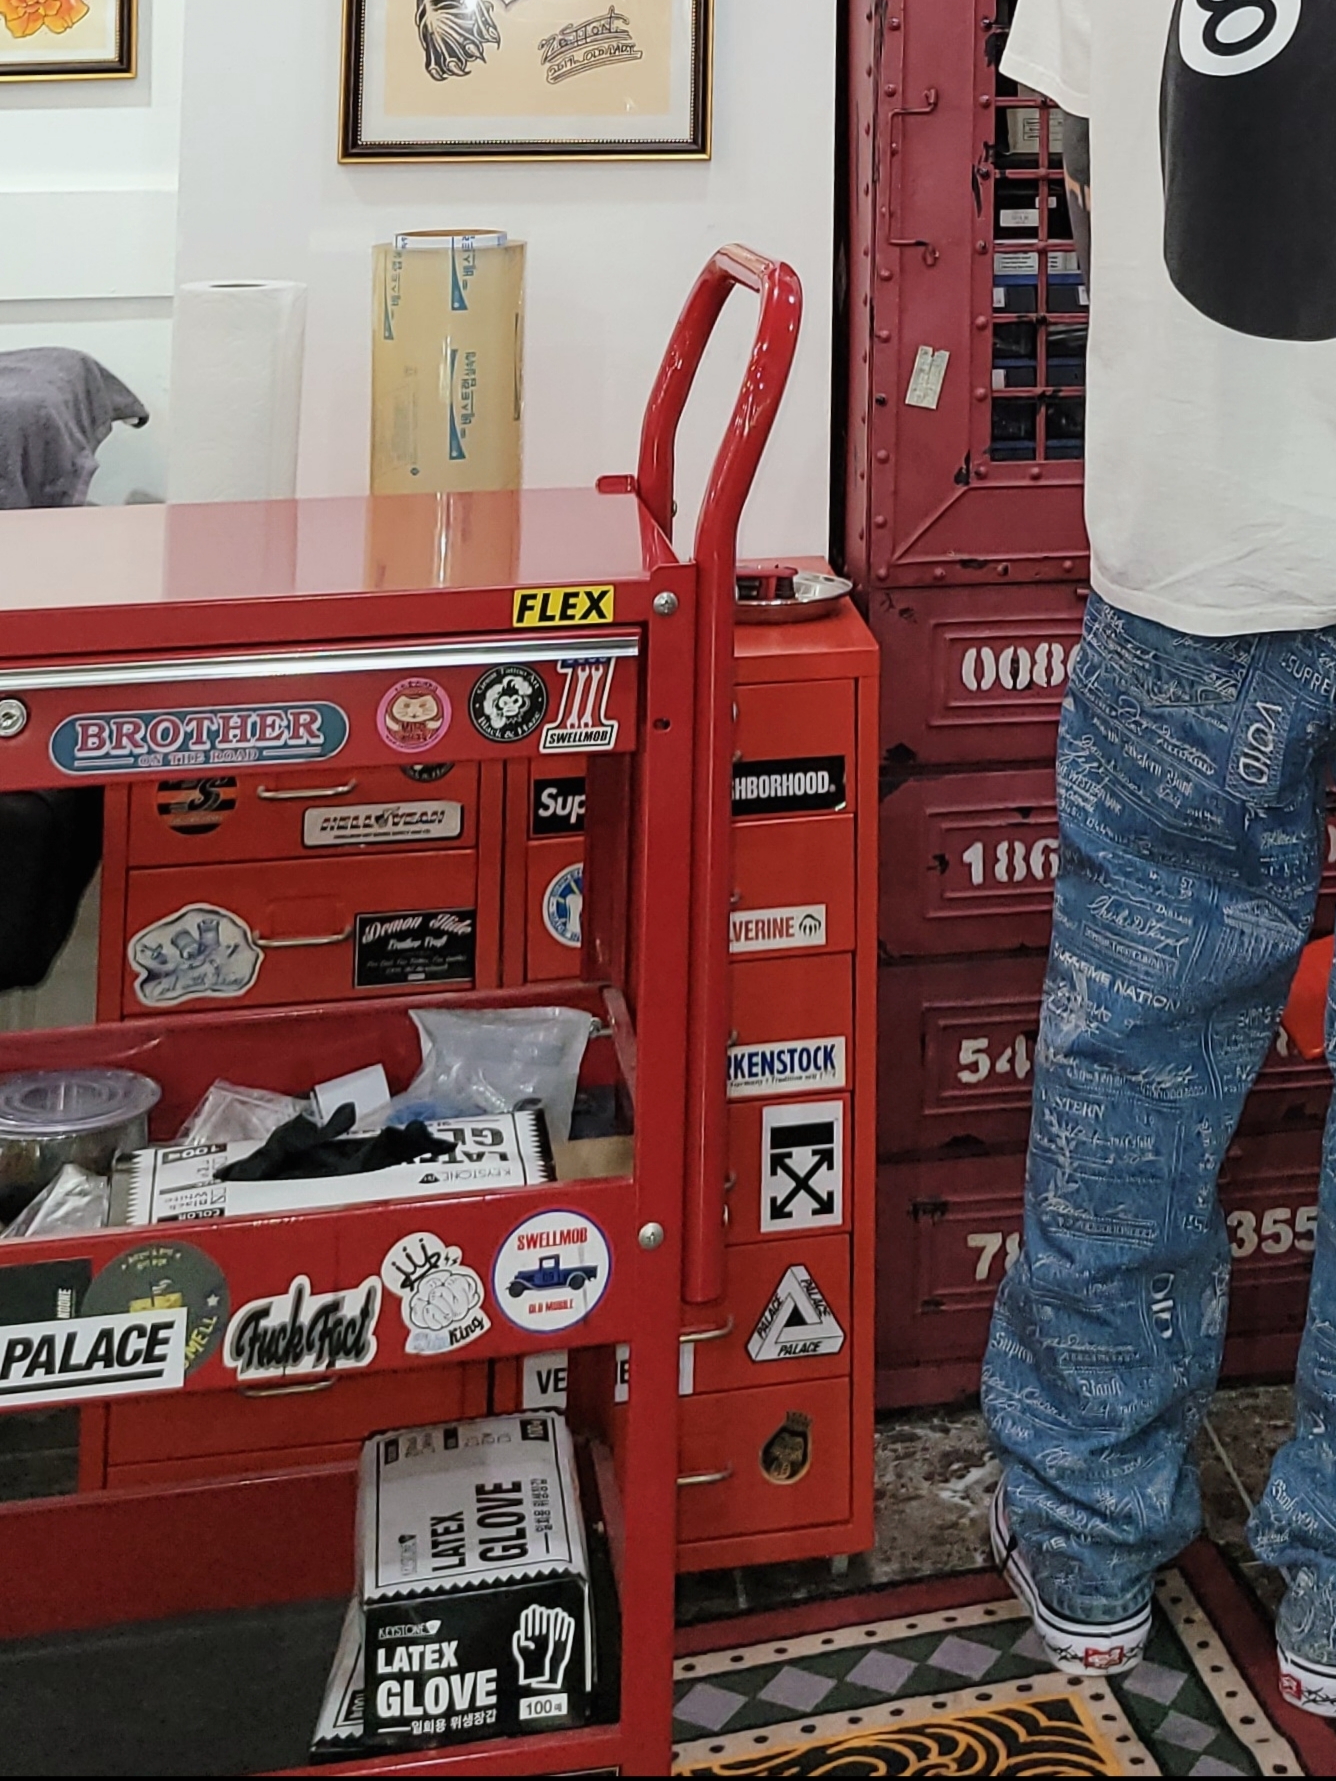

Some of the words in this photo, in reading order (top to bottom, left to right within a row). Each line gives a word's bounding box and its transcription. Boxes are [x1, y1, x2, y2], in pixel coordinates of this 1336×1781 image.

[516, 589, 609, 622] FLEX
[75, 709, 324, 755] BROTHER
[548, 730, 608, 744] SWELLMOB
[1239, 701, 1282, 785] VOID
[139, 755, 162, 766] ON
[169, 753, 204, 764] THE
[210, 750, 258, 762] ROAD
[1114, 979, 1182, 1013] NATION
[441, 1168, 513, 1181] KEYSTONE
[517, 1227, 588, 1250] SWELLMOB
[800, 1279, 830, 1317] PALACE
[449, 1317, 485, 1346] King
[756, 1296, 782, 1337] PALACE
[0, 1320, 176, 1380] PALACE
[778, 1341, 822, 1356] PALACE
[475, 1480, 529, 1563] GLOVE
[430, 1511, 466, 1572] LATEX
[378, 1623, 430, 1639] KEYSTONE
[377, 1640, 458, 1673] LATEX
[377, 1669, 497, 1719] GLOVE
[411, 1719, 447, 1735] 일회용
[450, 1709, 497, 1730] 위생장갑
